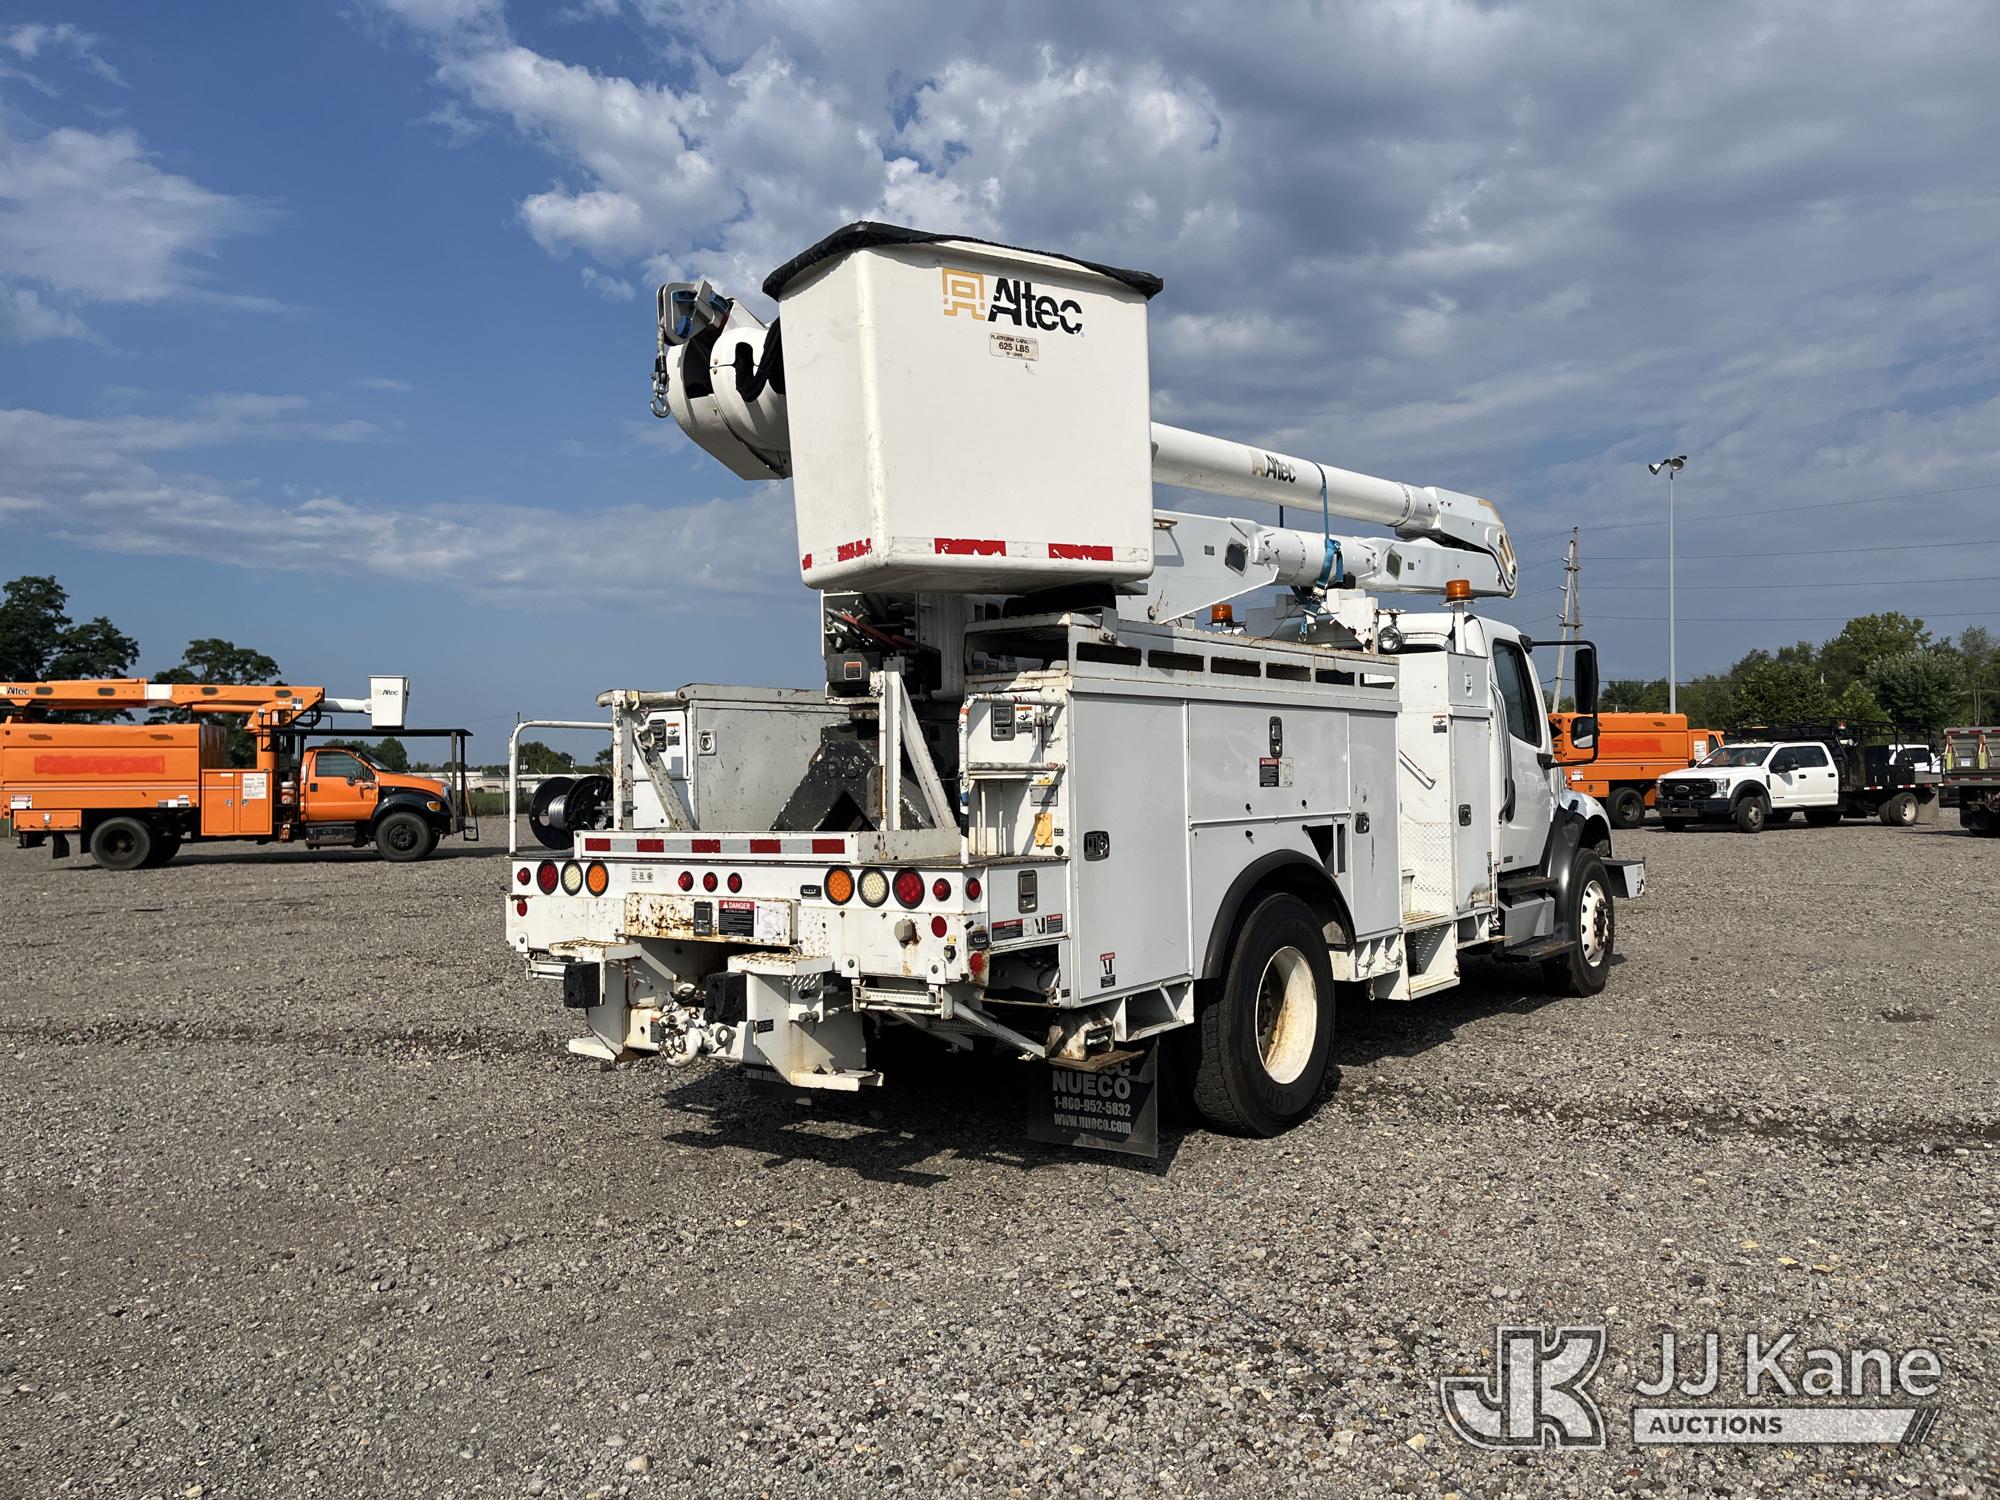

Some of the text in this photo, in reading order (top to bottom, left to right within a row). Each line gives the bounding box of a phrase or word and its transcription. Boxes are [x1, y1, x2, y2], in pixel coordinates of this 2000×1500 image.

[987, 277, 1083, 334] Altec
[998, 341, 1030, 354] 625 LBS
[1265, 454, 1297, 483] Altec
[7, 686, 30, 696] Altec
[728, 902, 751, 910] DANGER
[1052, 1070, 1131, 1100] NUECO
[1053, 1095, 1131, 1117] 1-800-952-5832
[1053, 1112, 1132, 1135] www.nueco.com
